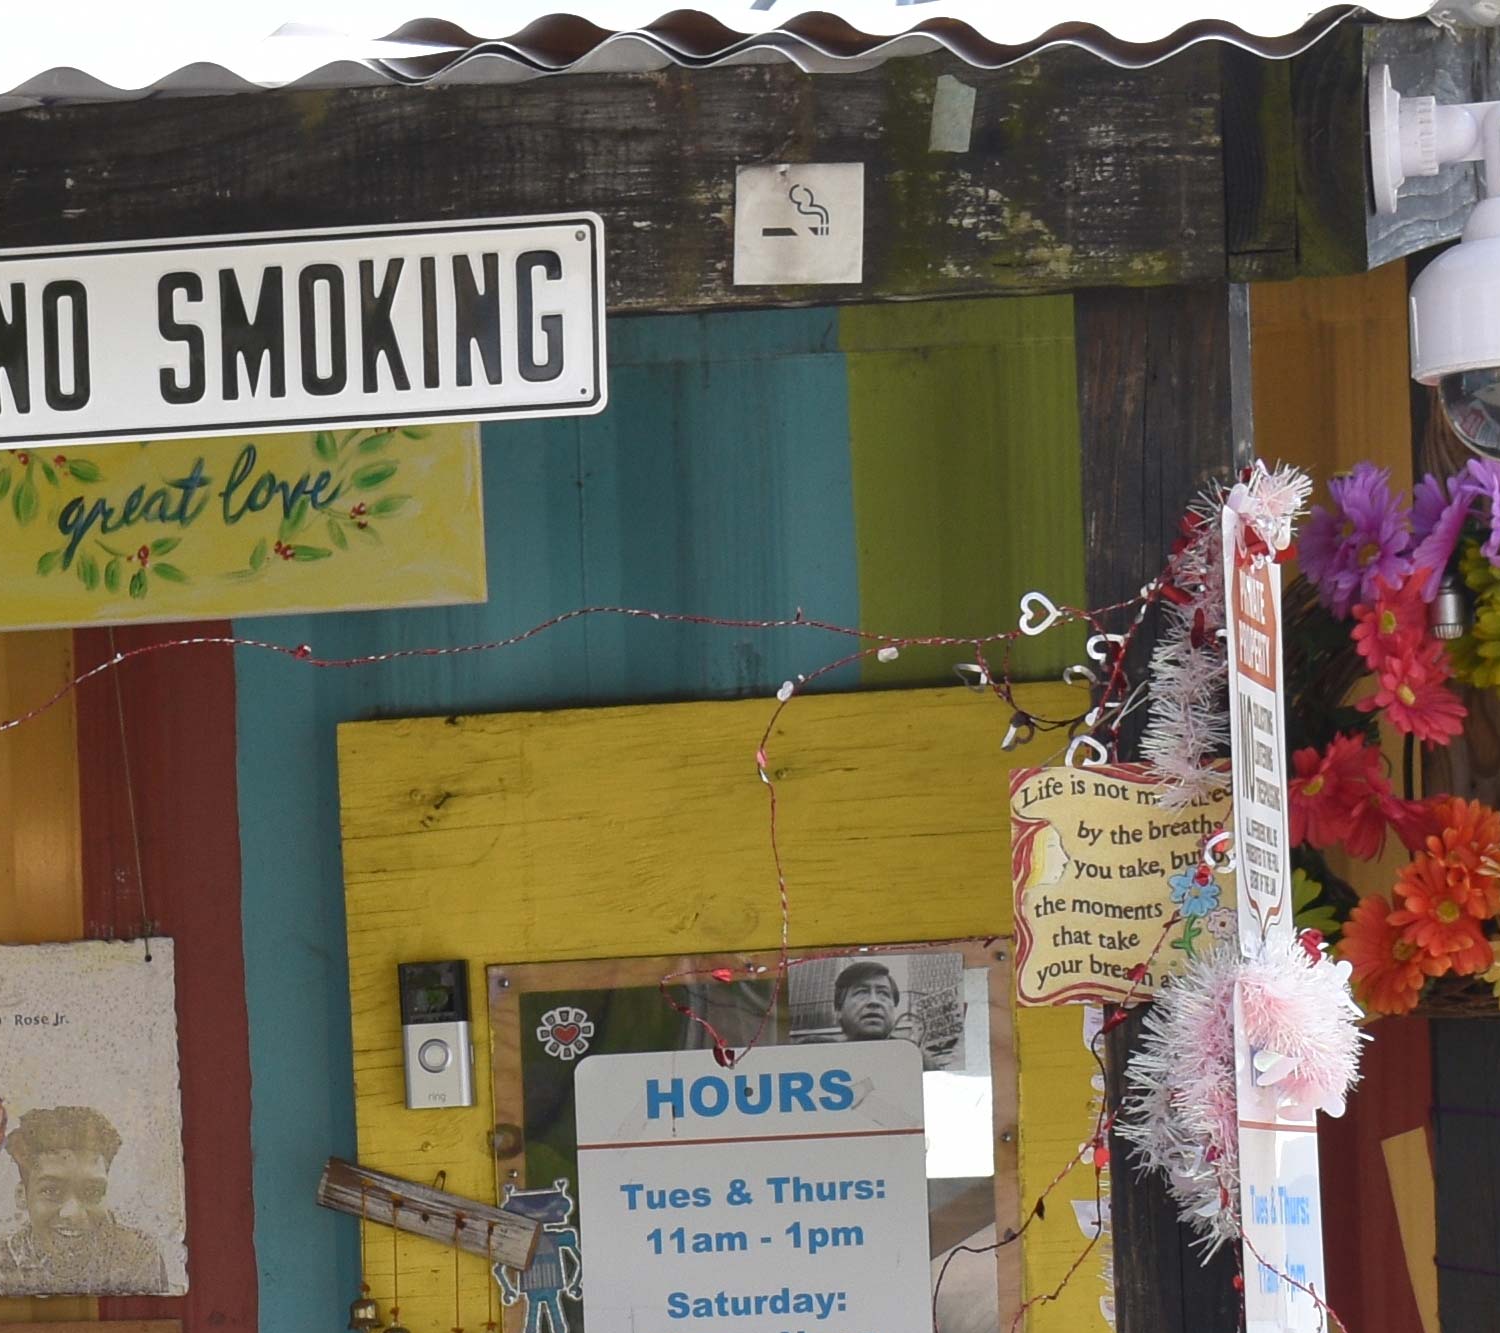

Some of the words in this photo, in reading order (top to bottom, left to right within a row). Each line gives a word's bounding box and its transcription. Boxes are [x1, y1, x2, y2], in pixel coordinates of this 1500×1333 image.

[157, 249, 564, 405] SMOKING
[57, 461, 209, 570] great
[220, 447, 346, 524] love
[1021, 776, 1064, 808] Life
[1070, 775, 1085, 795] is
[1094, 782, 1129, 800] not
[1078, 821, 1103, 846] by
[1111, 827, 1142, 845] the
[1073, 859, 1112, 879] you
[1119, 859, 1165, 878] take,
[1035, 897, 1066, 917] the
[1072, 899, 1163, 920] moments
[1053, 926, 1092, 947] that
[1099, 931, 1140, 950] take
[1036, 958, 1083, 989] your
[14, 1013, 48, 1027] Rose
[53, 1012, 70, 1027] Jr.
[646, 1069, 854, 1120] HOURS
[620, 1183, 711, 1210] Tues
[726, 1179, 753, 1207] &
[767, 1176, 885, 1205] Thurs:
[646, 1227, 748, 1255] 11am
[785, 1221, 864, 1255] 1pm
[667, 1288, 847, 1321] Saturday:
